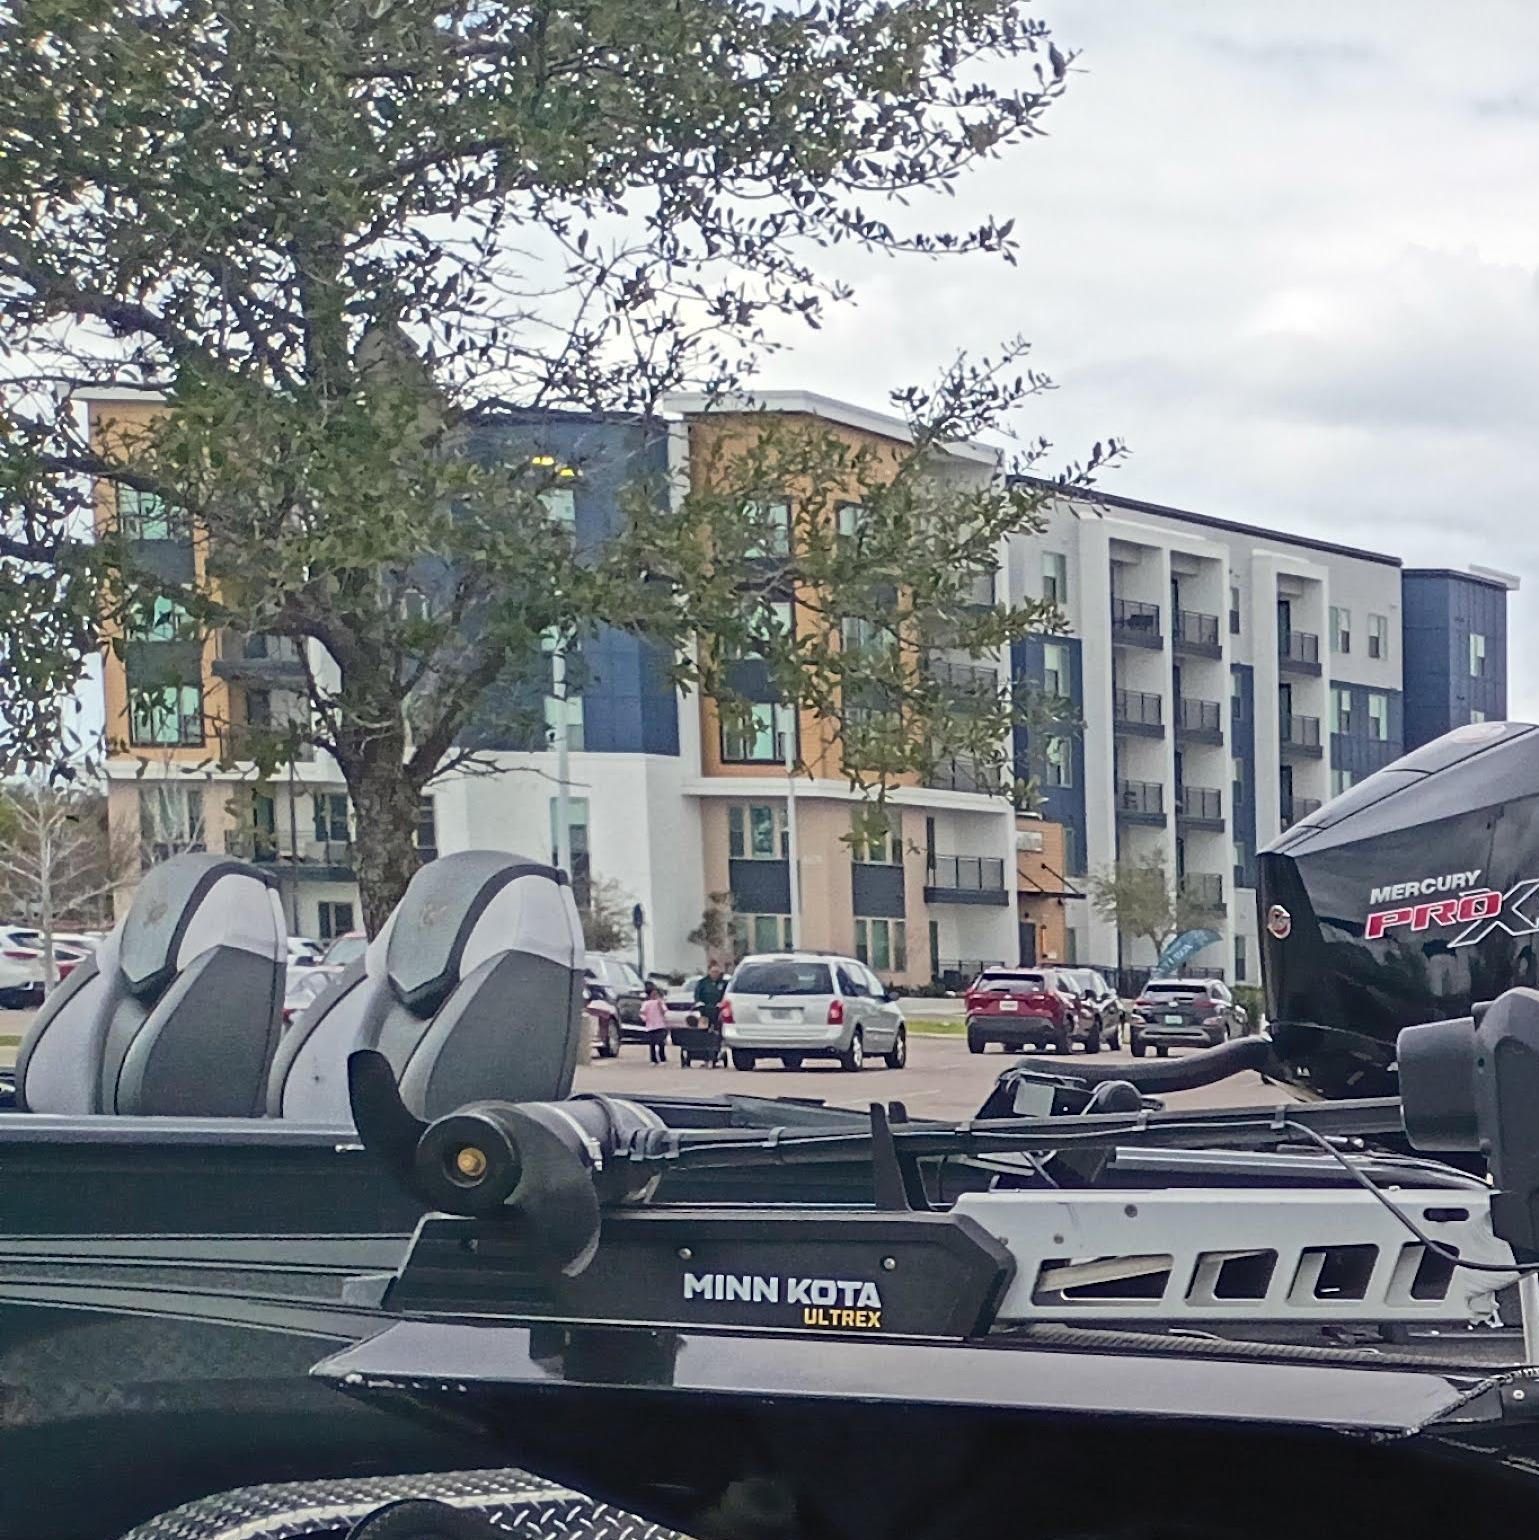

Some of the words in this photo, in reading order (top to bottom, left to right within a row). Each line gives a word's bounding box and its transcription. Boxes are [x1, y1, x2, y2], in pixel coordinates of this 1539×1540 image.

[1369, 869, 1482, 905] MERCURY
[683, 1272, 779, 1303] MINN
[787, 1278, 882, 1308] KOTA
[803, 1308, 881, 1328] ULTREX
